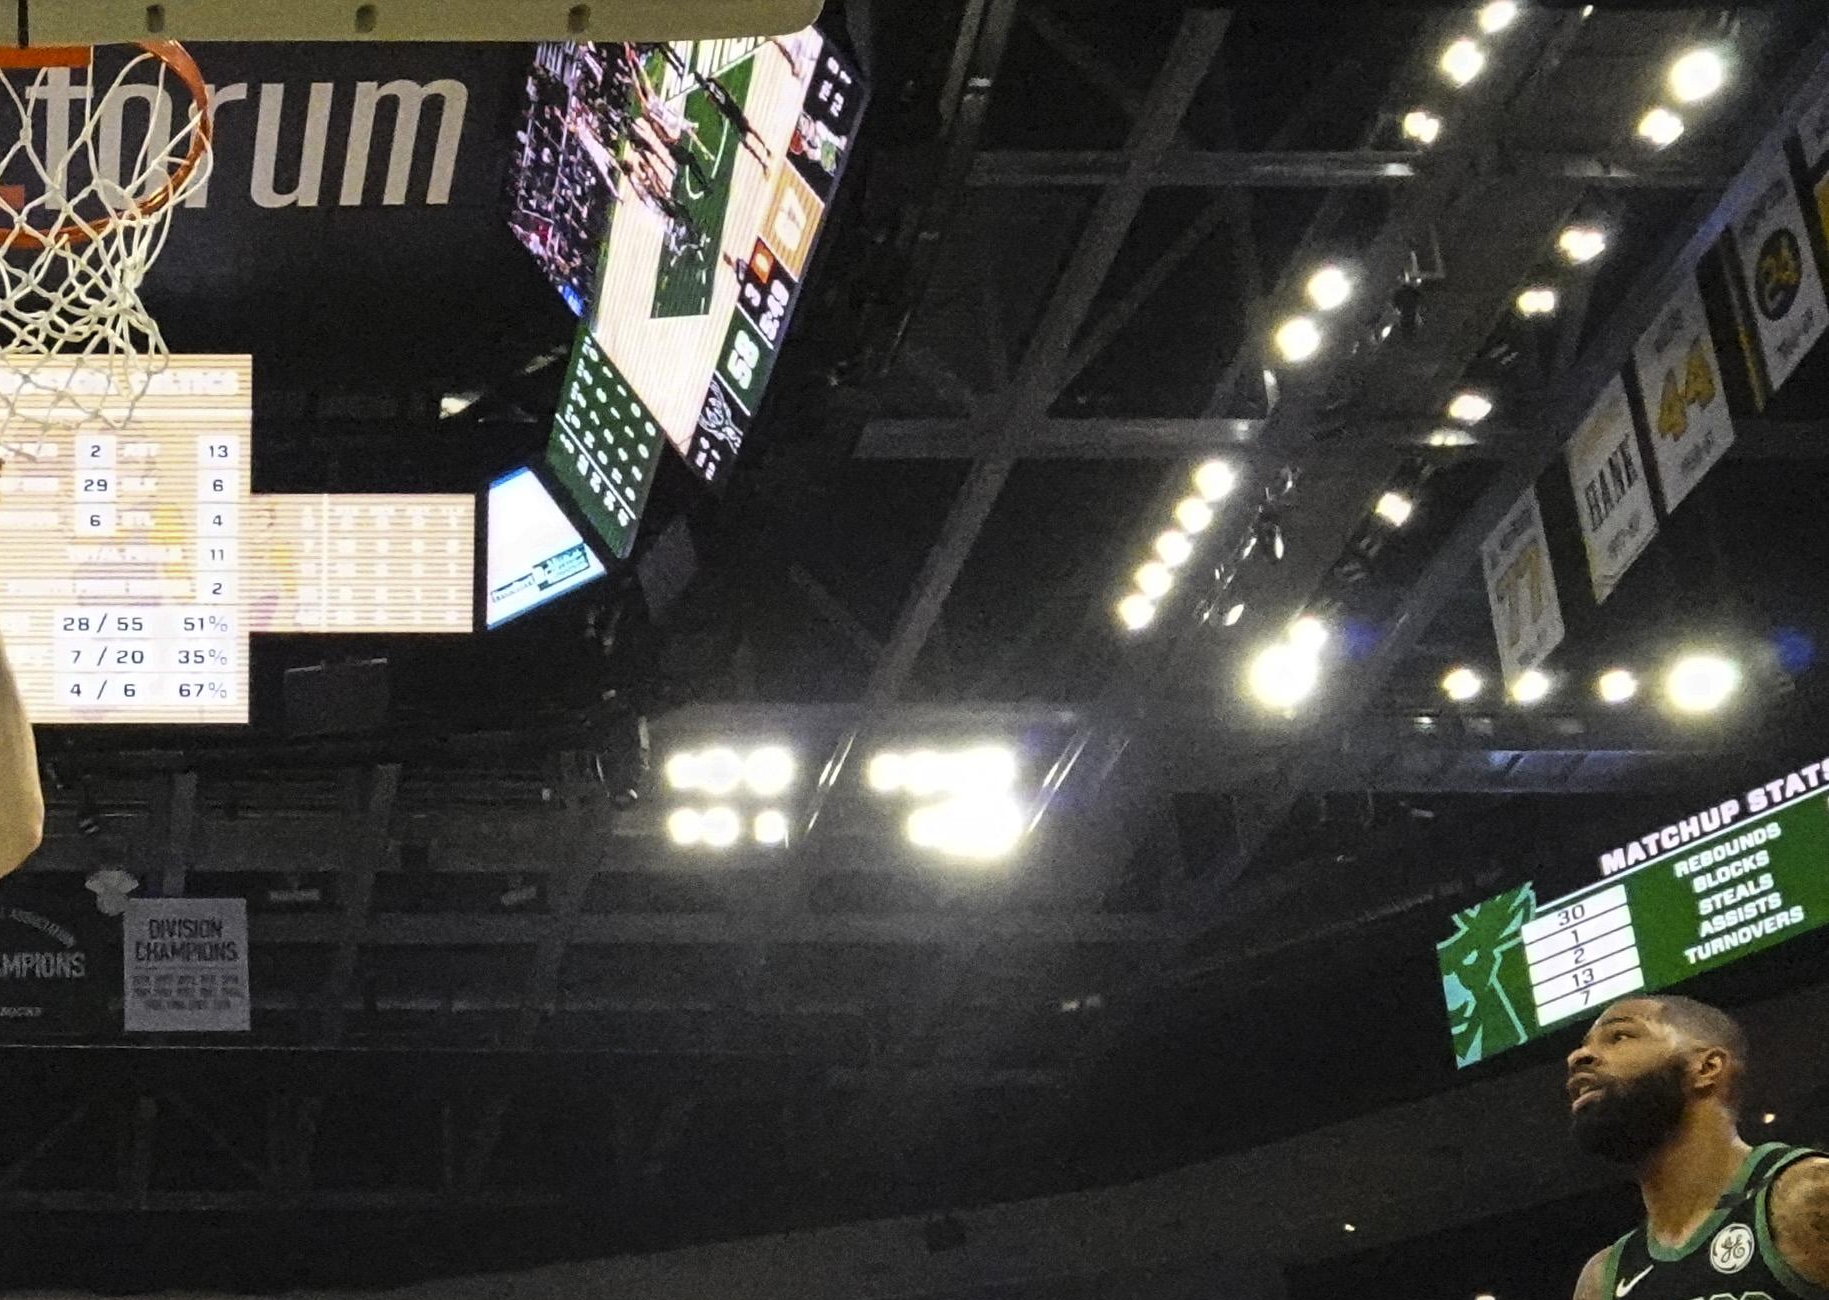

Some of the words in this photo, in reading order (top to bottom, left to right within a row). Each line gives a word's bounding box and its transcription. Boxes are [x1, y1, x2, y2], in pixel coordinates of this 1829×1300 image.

[25, 66, 469, 210] forum
[727, 329, 759, 390] 58
[91, 445, 101, 458] 2
[209, 445, 228, 458] 13
[84, 479, 108, 492] 29
[212, 479, 223, 492] 6
[90, 514, 101, 527] 6
[212, 514, 223, 527] 4
[210, 549, 225, 561] 11
[212, 583, 223, 595] 2
[63, 617, 90, 631] 28
[117, 617, 143, 631] 55
[183, 615, 228, 632] 51%
[71, 650, 81, 665] 7
[116, 650, 144, 665] 20
[178, 648, 228, 665] 35%
[70, 683, 82, 698] 4
[124, 683, 136, 698] 6
[178, 681, 228, 699] 67%
[1599, 798, 1739, 876] MATCHUP
[1557, 903, 1586, 928] 30
[1673, 821, 1782, 878] REBOUNDS
[1572, 929, 1580, 944] 1
[1692, 849, 1770, 894] BLOCKS
[1572, 948, 1586, 965] 2
[1698, 872, 1774, 916] STEALS
[149, 917, 223, 940] DIVISION
[1571, 967, 1595, 989] 13
[1699, 892, 1783, 938] ASSISTS
[135, 940, 239, 962] CHAMPIONS
[1581, 989, 1591, 1005] 7
[1683, 904, 1805, 966] TURNOVERS
